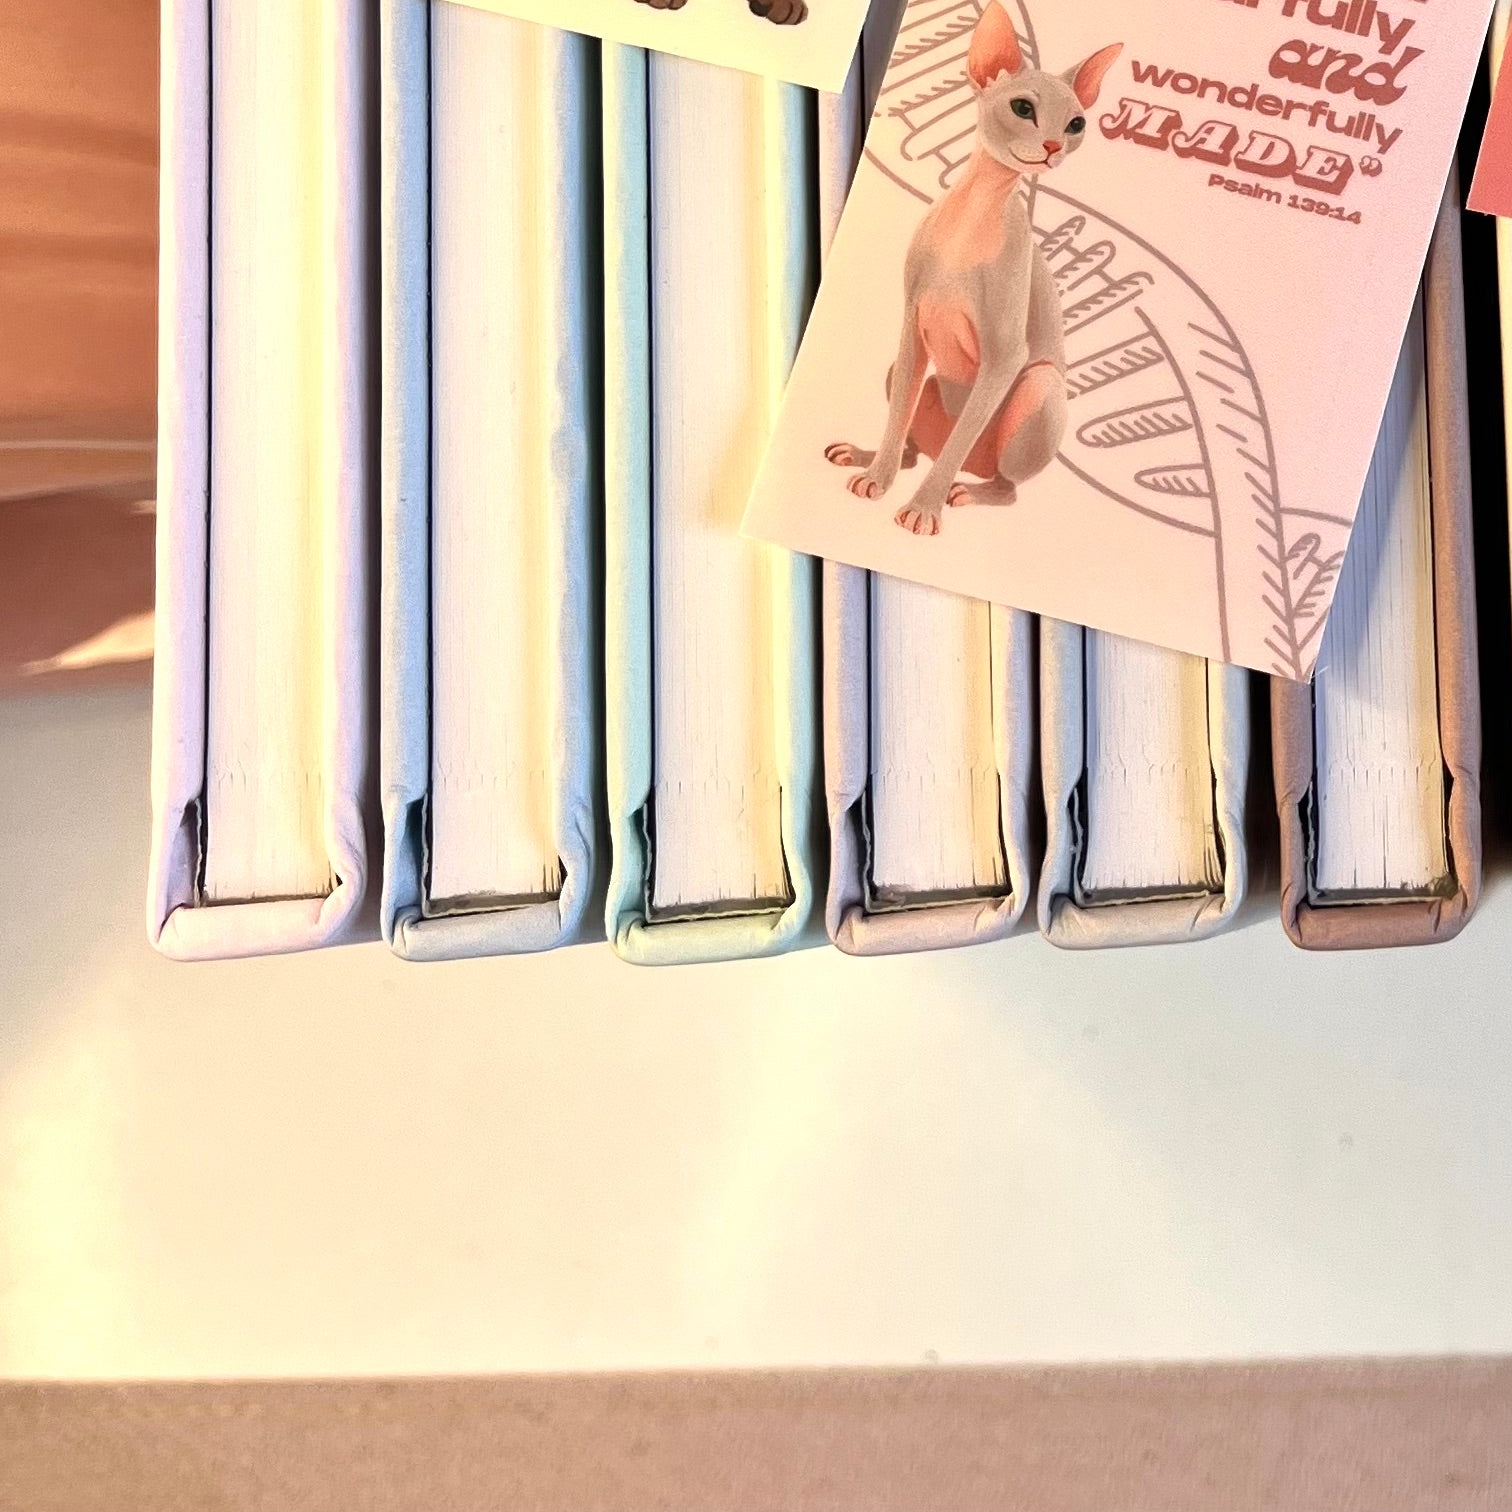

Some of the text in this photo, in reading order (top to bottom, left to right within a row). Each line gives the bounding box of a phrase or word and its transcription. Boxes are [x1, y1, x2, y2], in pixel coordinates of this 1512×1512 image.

[1268, 39, 1425, 106] and
[1131, 60, 1403, 154] wonderfully
[1208, 173, 1362, 225] Psalm 139:14
